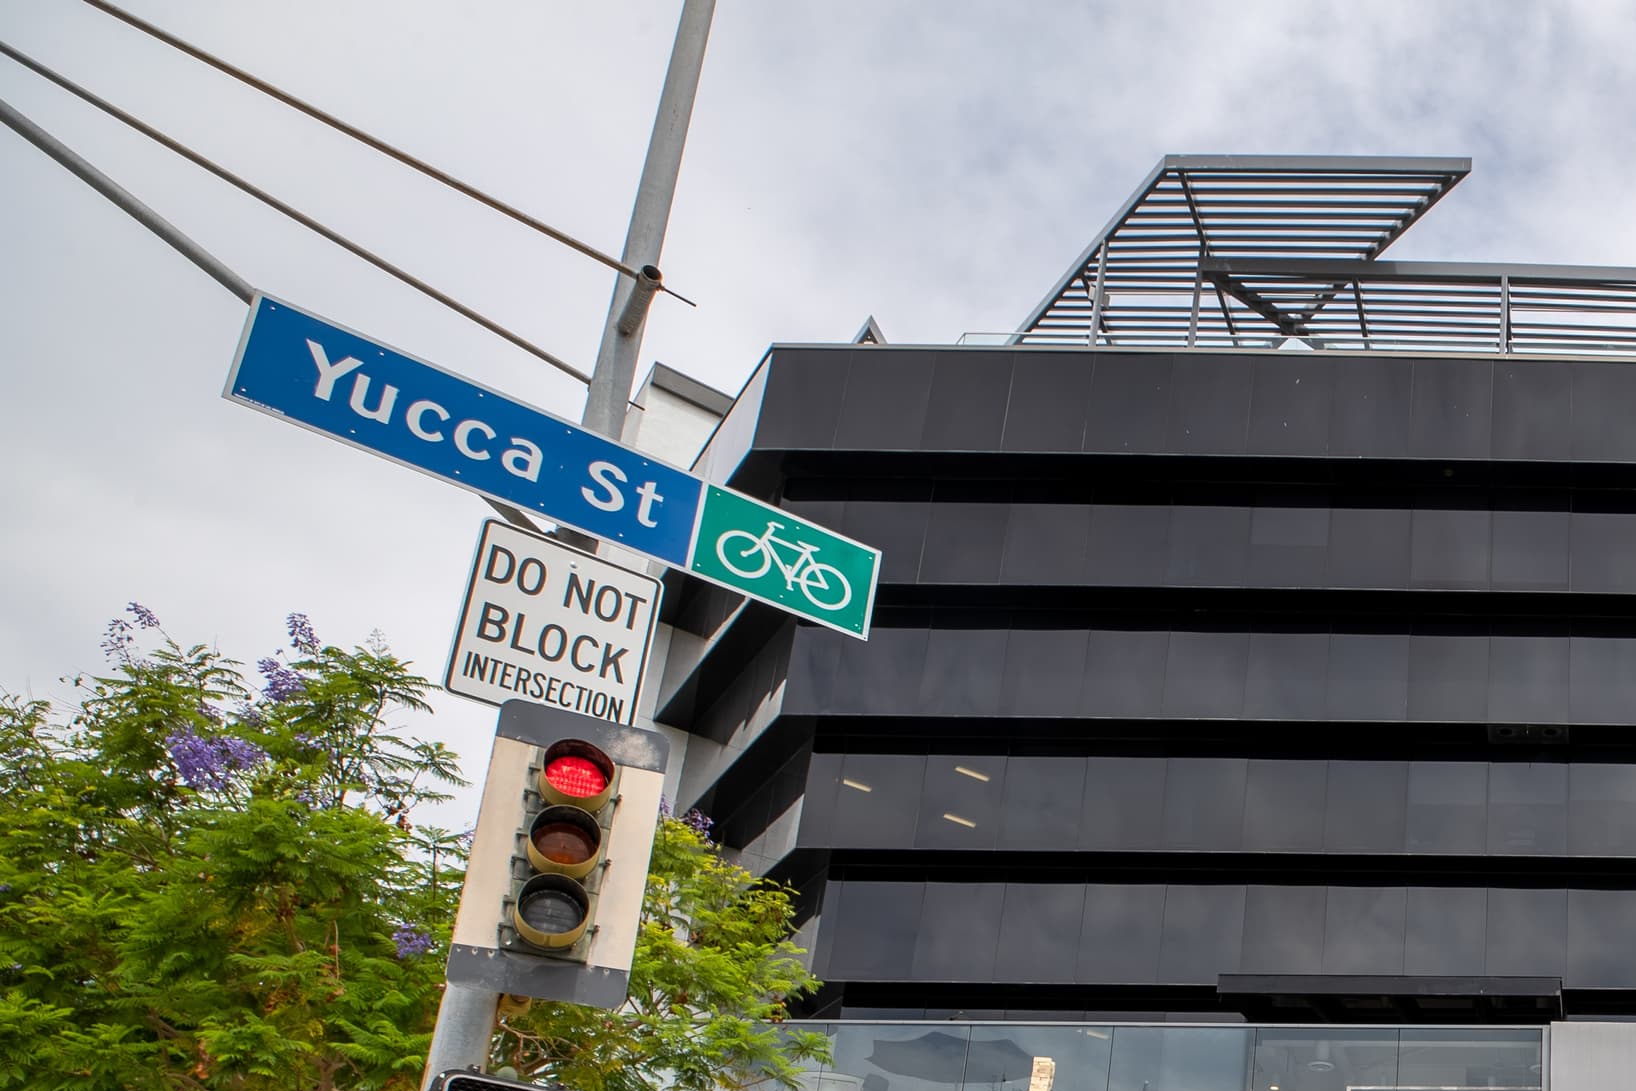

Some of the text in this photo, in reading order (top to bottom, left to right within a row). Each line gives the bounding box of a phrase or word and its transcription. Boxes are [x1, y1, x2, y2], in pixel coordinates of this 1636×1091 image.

[305, 338, 664, 528] Yucca St
[484, 544, 647, 630] DO NOT
[476, 601, 628, 684] BLOCK
[463, 651, 624, 724] INTERSECTION
